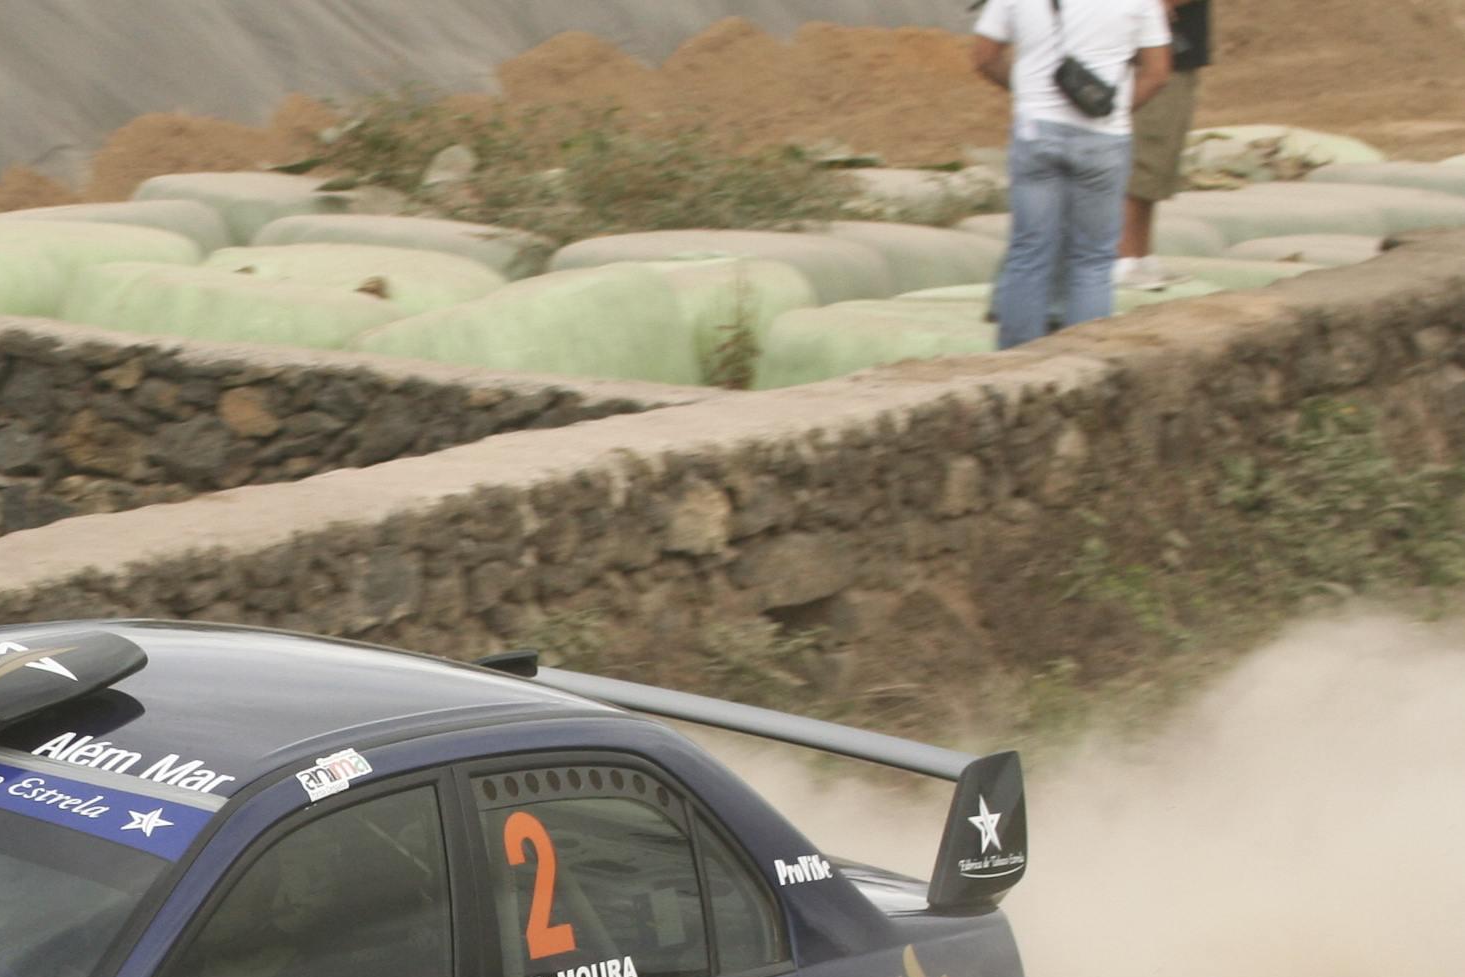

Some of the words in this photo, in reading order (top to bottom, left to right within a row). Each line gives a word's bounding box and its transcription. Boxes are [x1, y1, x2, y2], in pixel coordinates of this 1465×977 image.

[31, 732, 142, 774] Além
[139, 753, 236, 793] Mar
[8, 777, 111, 819] Estrela
[504, 811, 576, 960] 2
